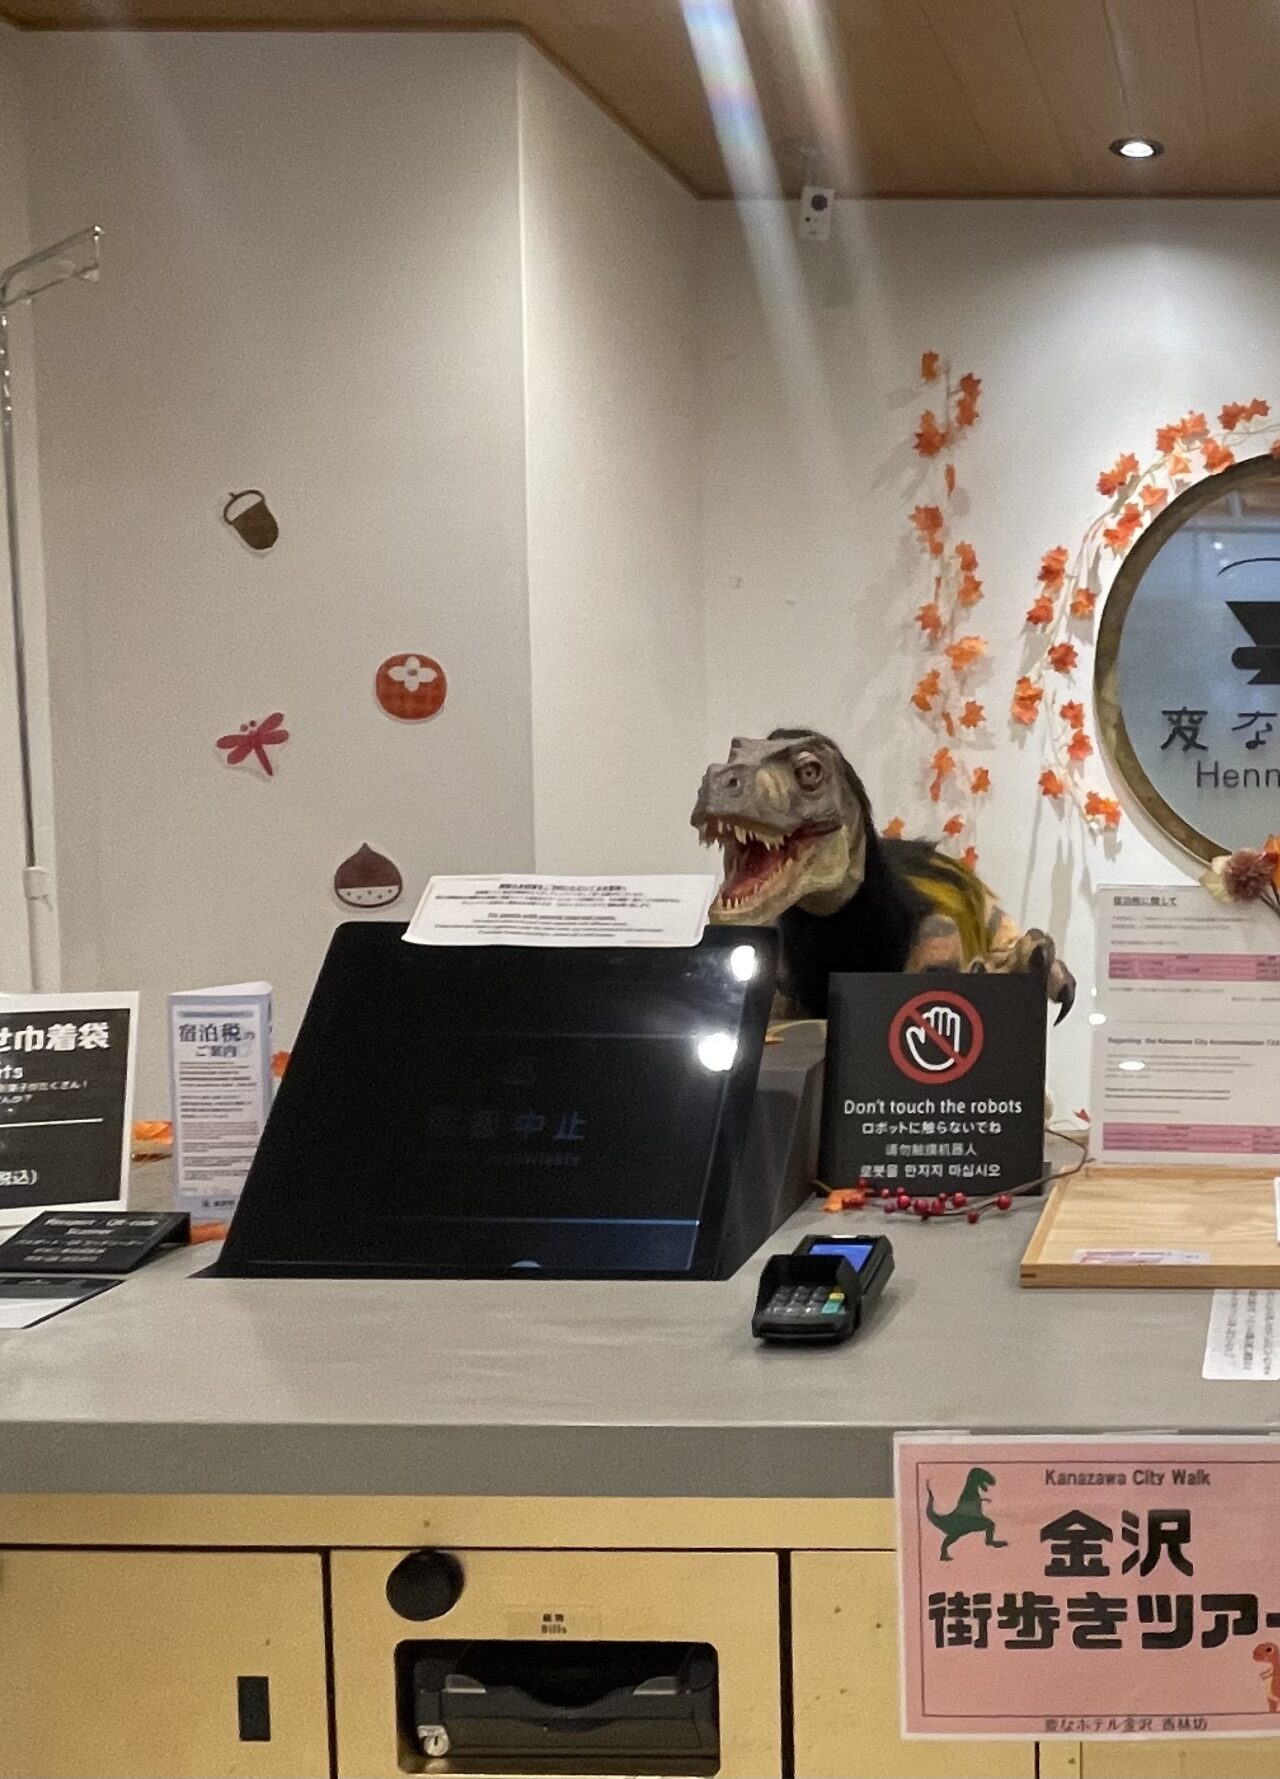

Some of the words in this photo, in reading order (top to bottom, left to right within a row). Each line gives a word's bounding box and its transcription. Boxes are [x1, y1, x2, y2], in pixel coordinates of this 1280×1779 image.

[0, 1065, 24, 1079] ts
[844, 1099, 886, 1114] Don't
[890, 1099, 936, 1114] touch
[940, 1099, 966, 1114] the
[971, 1098, 1022, 1114] robots
[1045, 1469, 1127, 1486] Kanazawa
[1132, 1469, 1164, 1487] City
[1171, 1469, 1211, 1486] Walk
[1040, 1509, 1194, 1577] 金沢
